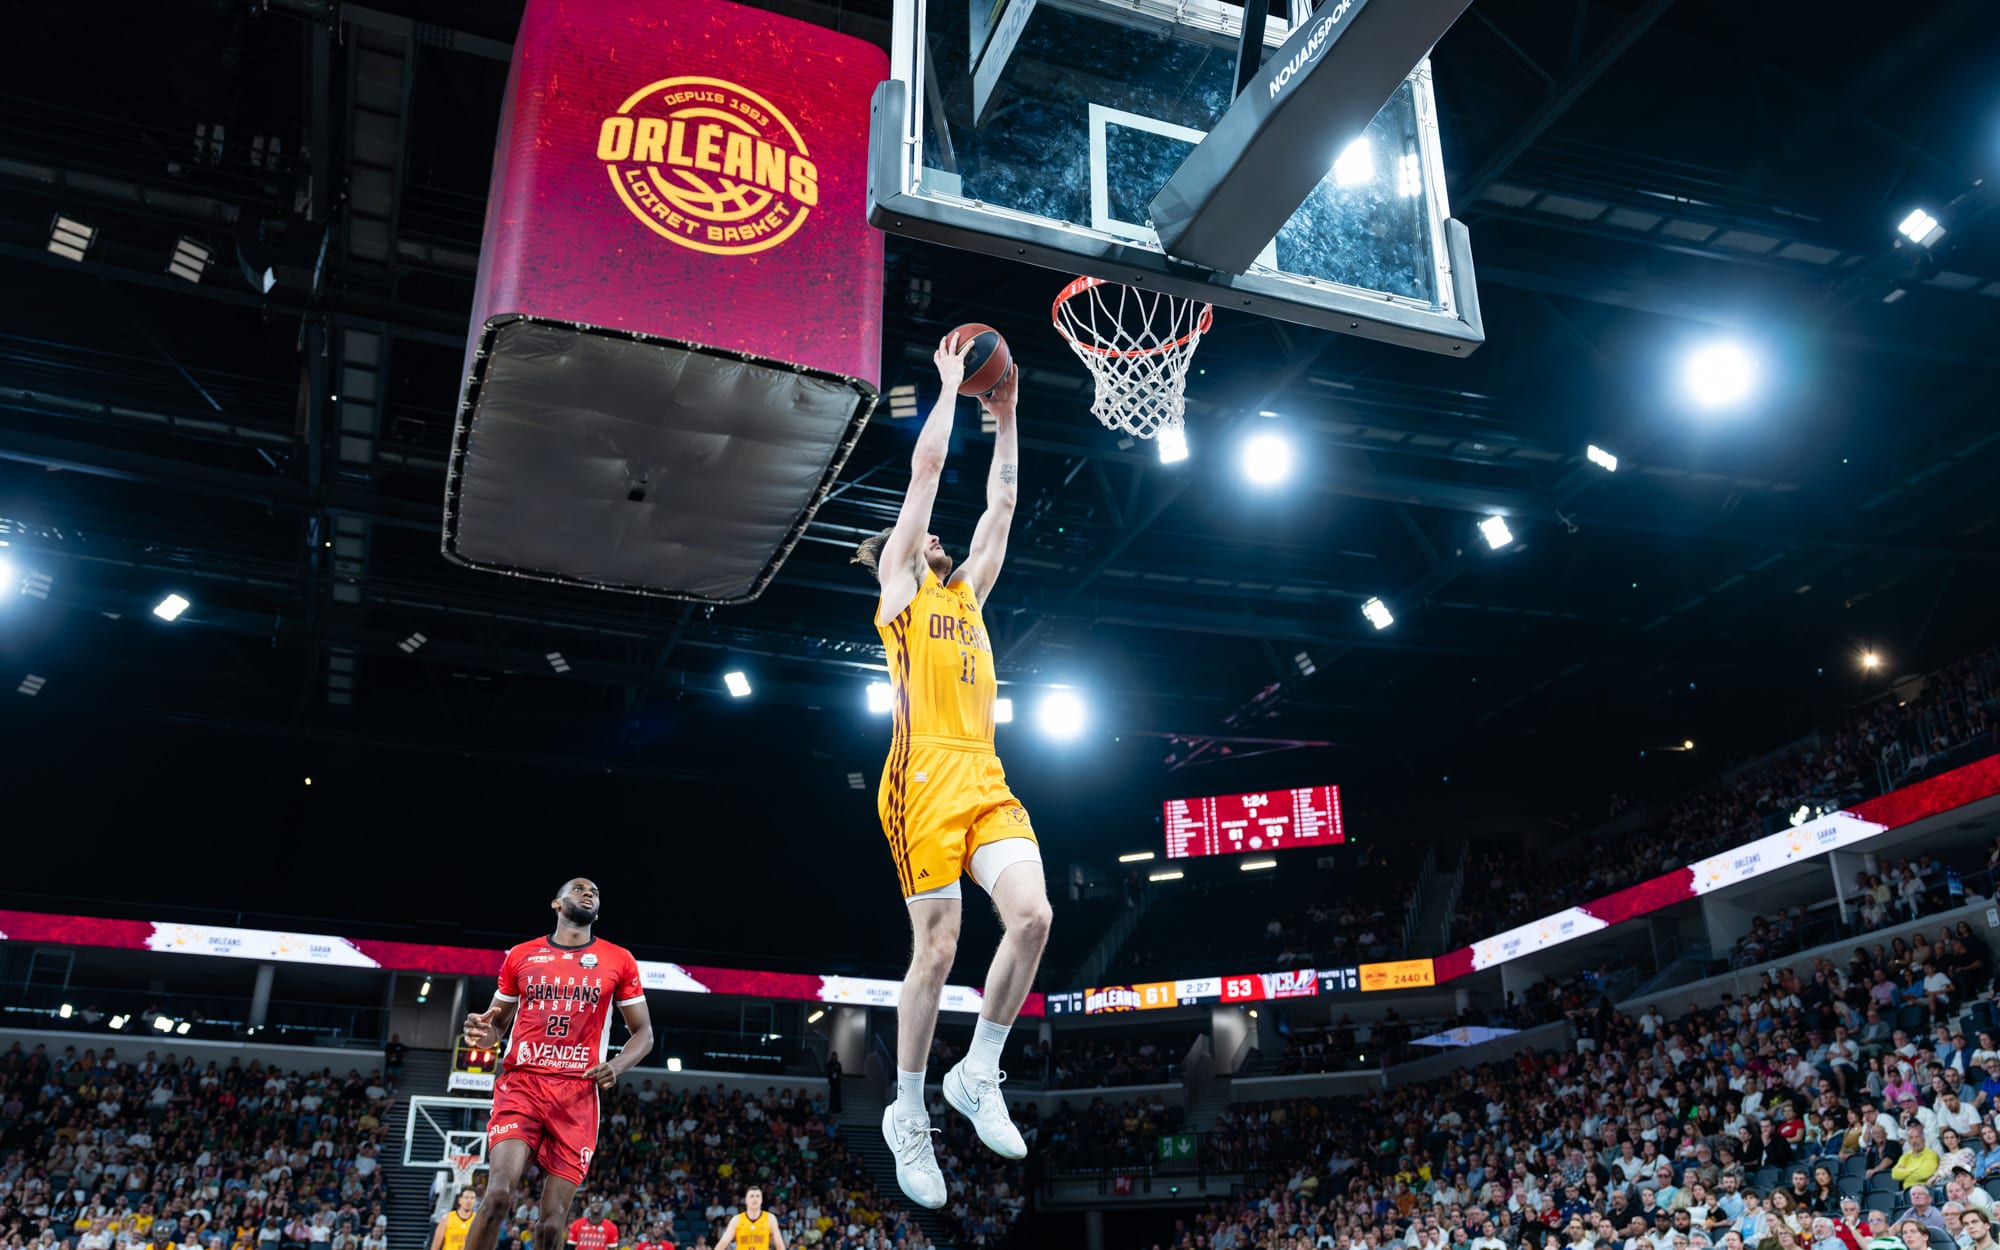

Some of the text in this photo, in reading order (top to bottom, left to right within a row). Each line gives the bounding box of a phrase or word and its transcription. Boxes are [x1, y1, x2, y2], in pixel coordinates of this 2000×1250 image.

[1269, 0, 1357, 98] NOUANSPOR
[664, 91, 770, 127] DEPUIS 1993
[597, 117, 818, 207] ORLÉANS
[625, 169, 792, 242] LOIRET BASKET
[960, 651, 975, 685] 11
[527, 975, 602, 987] VENDÉE
[1227, 979, 1252, 998] 53
[1325, 979, 1333, 990] 3
[526, 984, 601, 1003] CHALLANS
[1146, 986, 1168, 1004] 61
[527, 1000, 598, 1013] BASKET
[546, 1015, 570, 1037] 25
[532, 1041, 590, 1061] VENDÉE
[538, 1058, 588, 1069] DÉPARTEMENT
[455, 1076, 491, 1087] koesio
